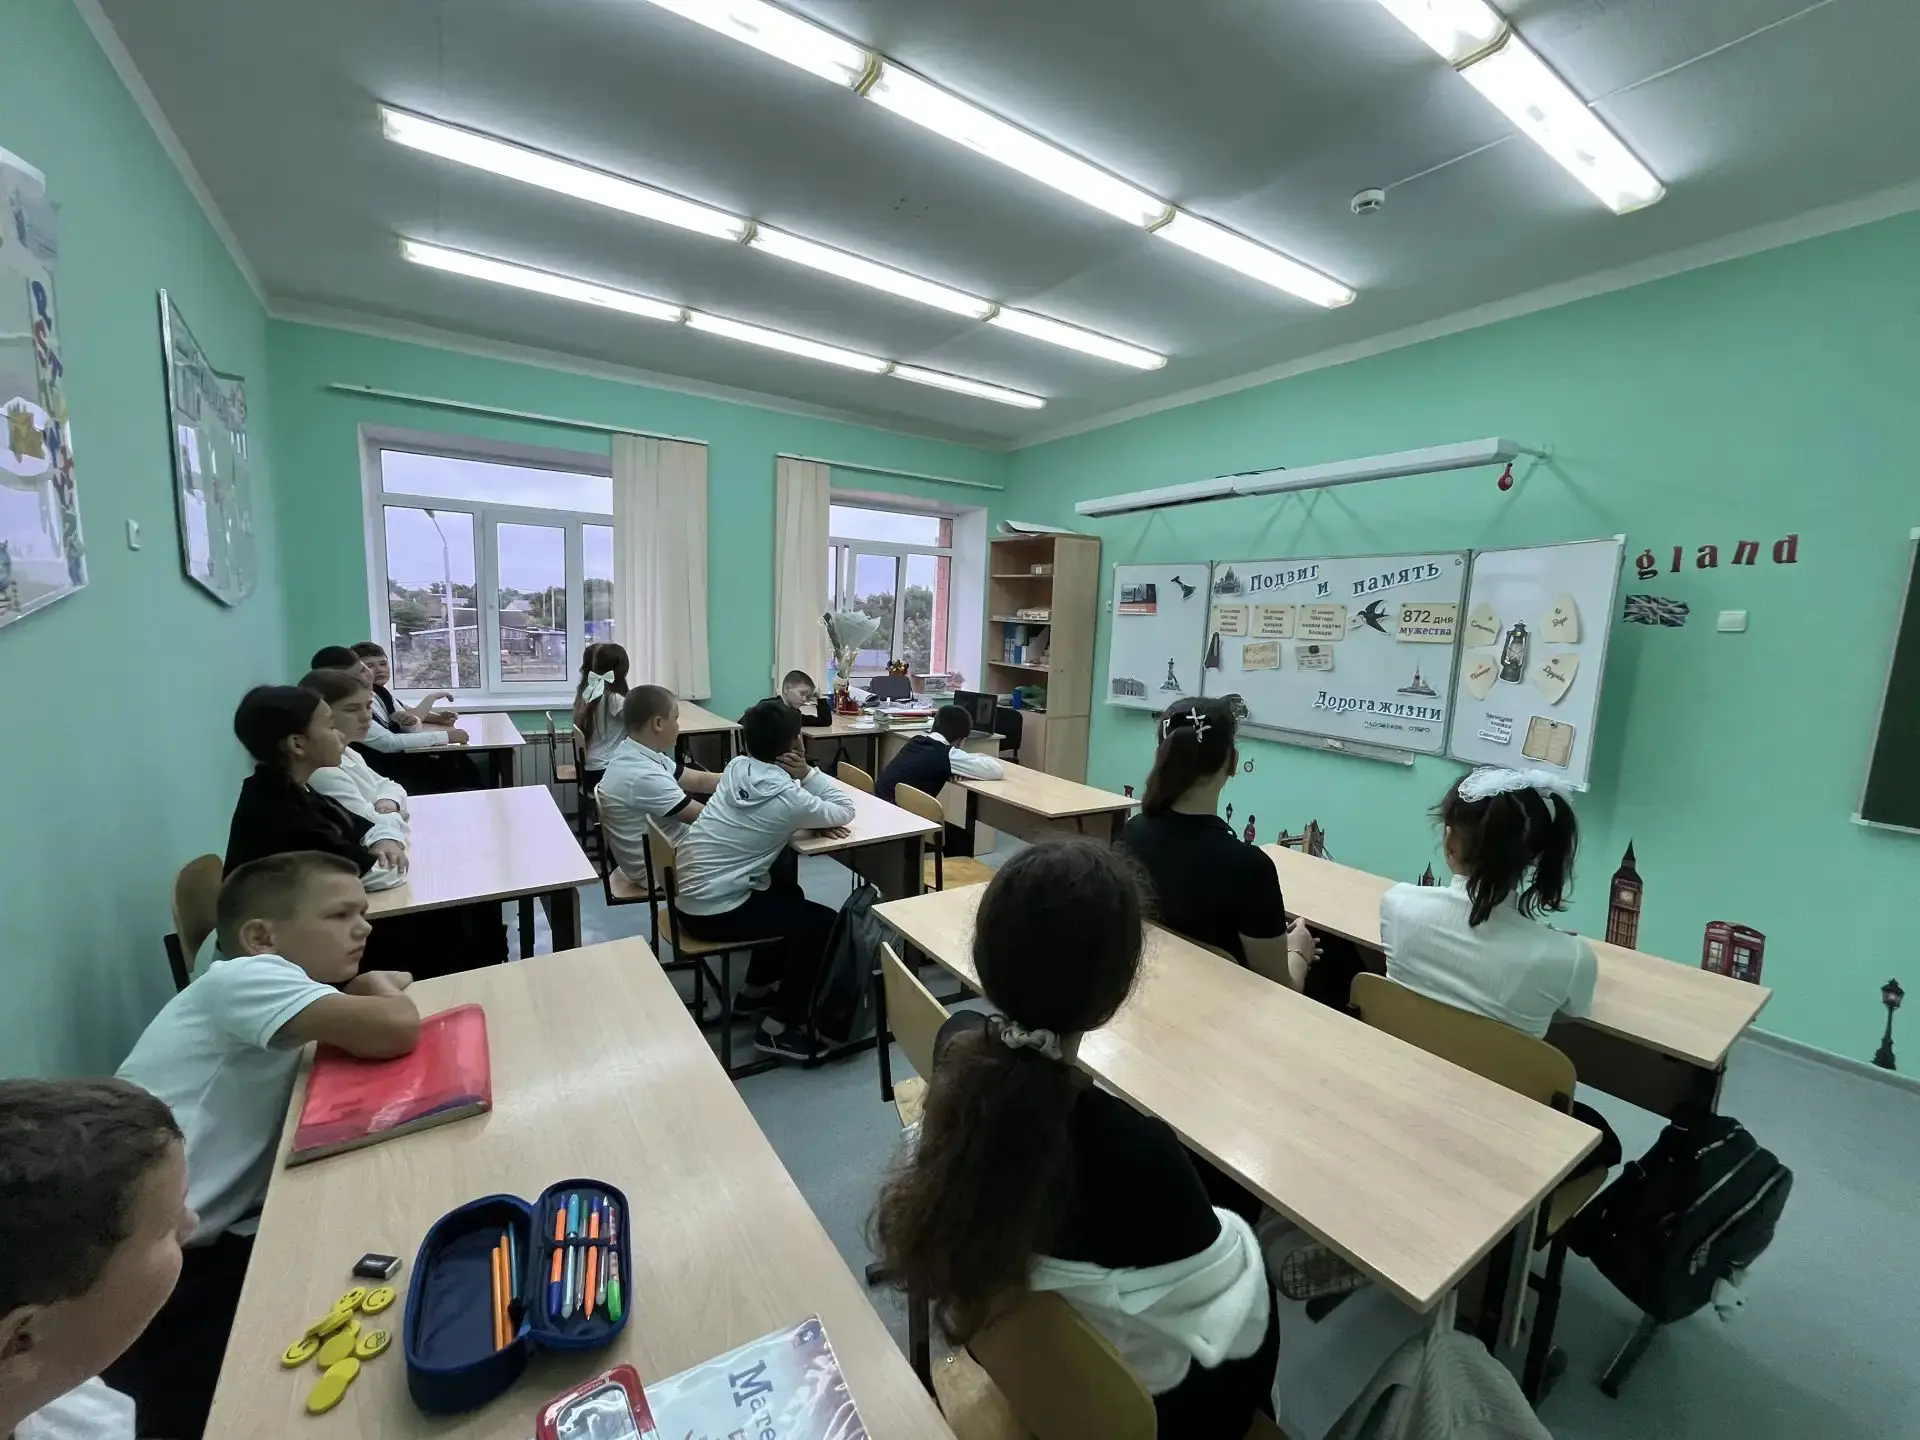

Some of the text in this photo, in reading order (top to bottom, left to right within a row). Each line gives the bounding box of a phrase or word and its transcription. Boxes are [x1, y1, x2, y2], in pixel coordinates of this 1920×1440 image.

[1250, 562, 1440, 596] Подвиг и память
[1403, 610, 1431, 624] 872
[1399, 626, 1452, 636] мужества
[1313, 690, 1442, 721] Дорога жизни
